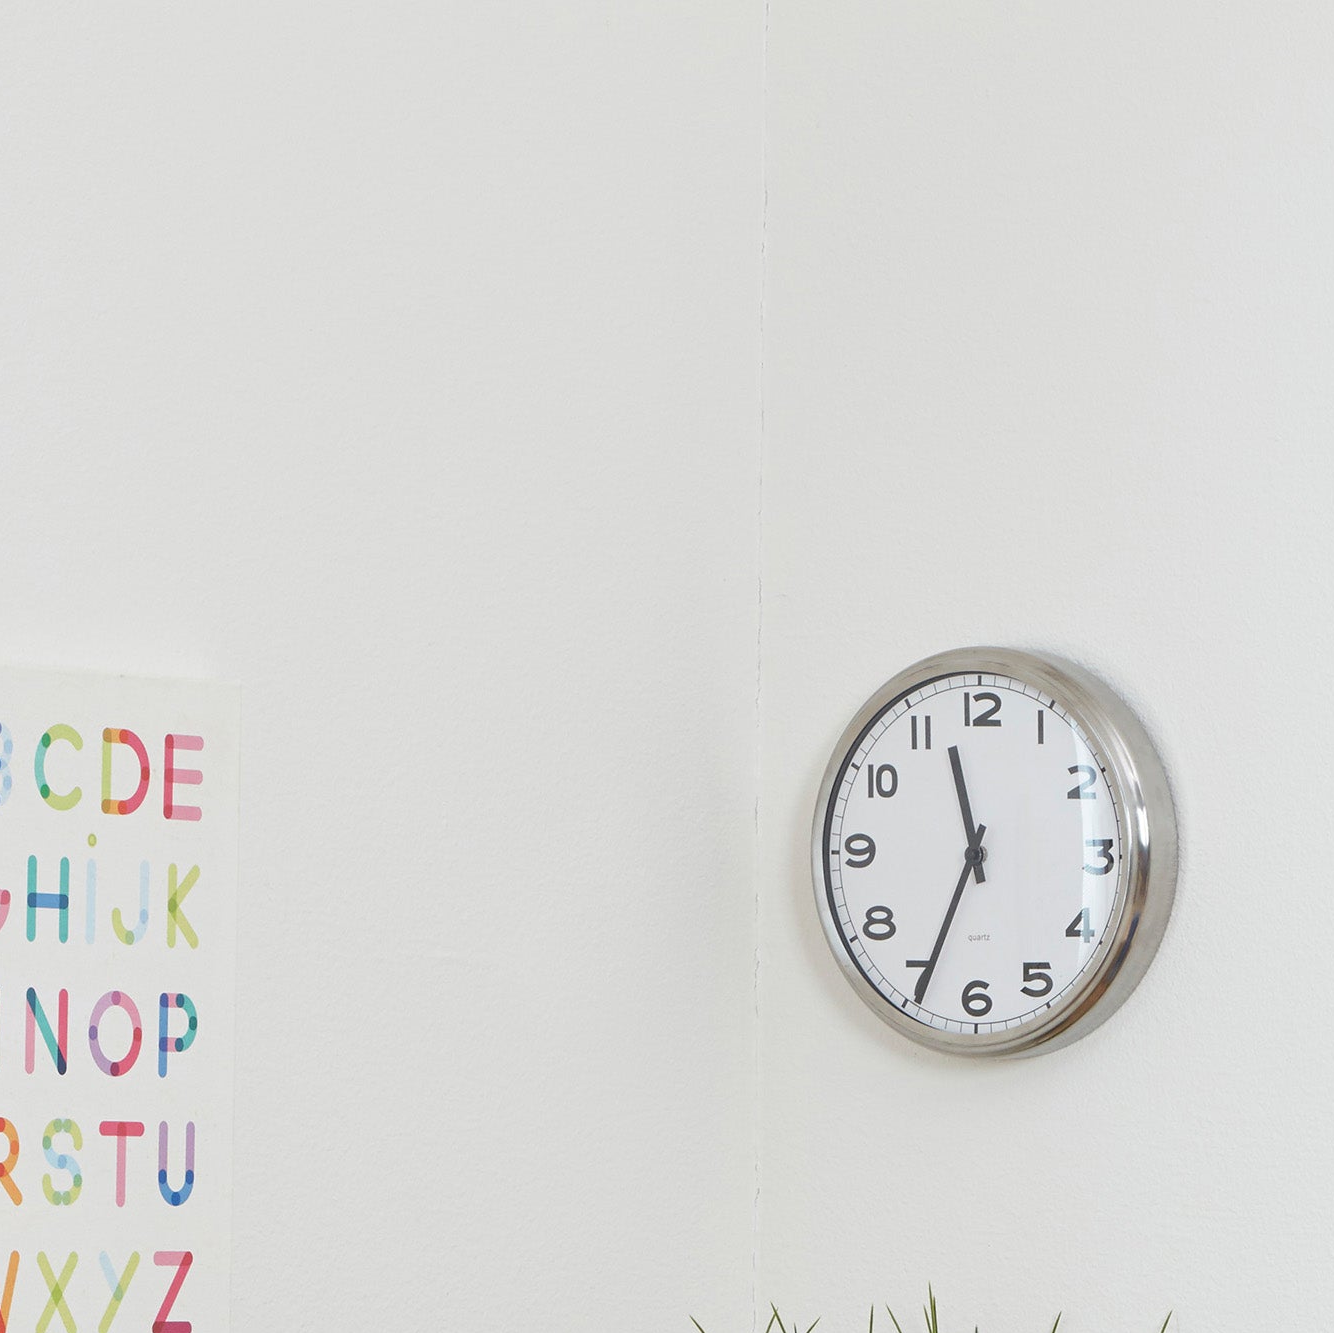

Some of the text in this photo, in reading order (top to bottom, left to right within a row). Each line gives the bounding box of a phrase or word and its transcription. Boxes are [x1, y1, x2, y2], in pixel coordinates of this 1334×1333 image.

[964, 692, 1002, 727] 12
[1038, 709, 1045, 745] 1
[911, 715, 932, 750] 11
[867, 764, 899, 799] 10
[1067, 764, 1098, 800] 2
[845, 833, 877, 869] 9
[1084, 838, 1115, 876] 3
[862, 905, 897, 941] 8
[967, 933, 991, 943] quartz
[1065, 907, 1096, 944] 4
[905, 959, 932, 1001] 7
[1020, 961, 1055, 998] 5
[961, 980, 994, 1018] 6
